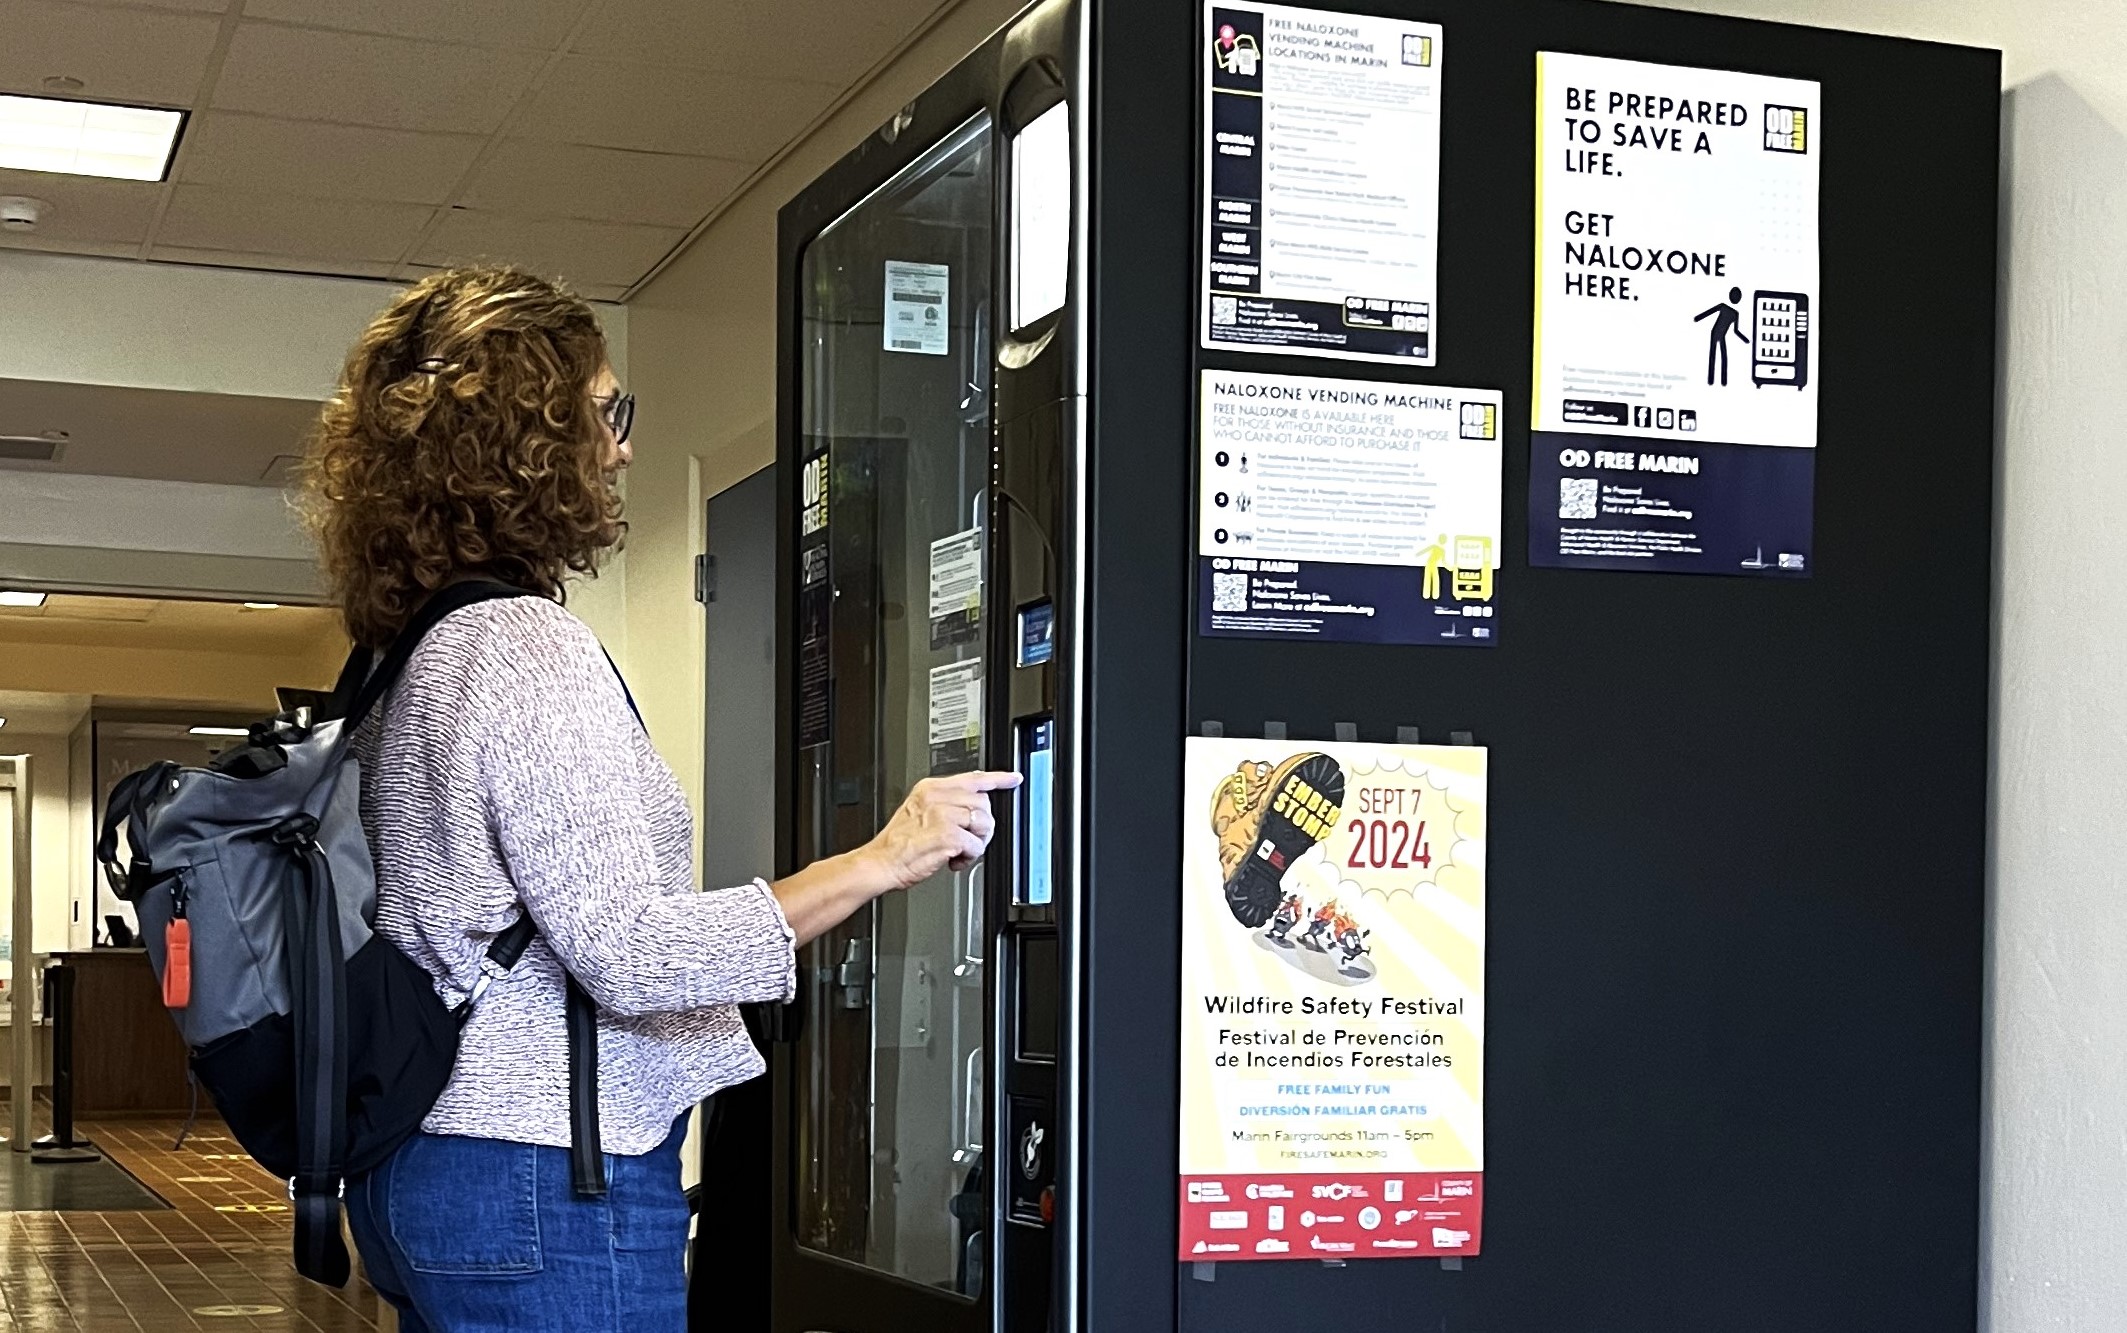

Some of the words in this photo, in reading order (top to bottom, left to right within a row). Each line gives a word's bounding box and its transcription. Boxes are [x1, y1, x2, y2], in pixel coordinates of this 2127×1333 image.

[1269, 47, 1330, 63] LOCATIONS
[1566, 87, 1596, 112] BE
[1608, 91, 1748, 127] PREPARED
[1565, 118, 1601, 143] TO
[1613, 123, 1682, 151] SAVE
[1693, 131, 1712, 155] A
[1565, 149, 1623, 177] LIFE.
[1565, 210, 1614, 237] GET
[1565, 241, 1726, 277] NALOXONE
[1565, 272, 1639, 301] HERE.
[1214, 382, 1302, 401] NALOXONE
[1308, 389, 1378, 407] VENDING
[1384, 393, 1453, 411] MACHINE
[1213, 403, 1236, 415] FREE
[1239, 405, 1298, 419] NALOXONE
[1302, 409, 1310, 420] IS
[1314, 410, 1367, 425] AVAILABLE
[1370, 414, 1395, 425] HERE
[1213, 416, 1233, 427] FOR
[1238, 417, 1271, 430] THOSE
[1275, 420, 1323, 433] WITHOUT
[1327, 423, 1386, 437] INSURANCE
[1390, 428, 1414, 439] AND
[1417, 429, 1449, 442] THOSE
[1213, 429, 1242, 441] WHO
[1245, 430, 1292, 443] CANNOT
[1296, 434, 1337, 446] AFFORD
[1340, 437, 1355, 448] TO
[1358, 438, 1410, 451] PURCHASE
[1412, 441, 1422, 452] IT
[1559, 448, 1591, 468] OD
[1594, 450, 1635, 470] FREE
[1638, 453, 1699, 475] MARIN
[1284, 774, 1341, 828] EMBER
[1359, 787, 1406, 815] SEPT
[1411, 789, 1421, 815] 7
[1273, 792, 1332, 842] STOMP
[1347, 819, 1431, 869] 2024
[1204, 995, 1293, 1015] Wildfire
[1301, 996, 1373, 1019] Safety
[1381, 997, 1464, 1015] Festival
[1219, 1029, 1296, 1045] Festival
[1302, 1029, 1326, 1045] de
[1334, 1029, 1444, 1046] Prevención
[1215, 1051, 1239, 1067] de
[1247, 1051, 1344, 1067] Incendios
[1351, 1051, 1452, 1067] Forestales
[1278, 1084, 1311, 1095] FREE
[1314, 1084, 1361, 1095] FAMILY
[1365, 1084, 1390, 1095] FUN
[1239, 1103, 1311, 1116] DIVERSIÓN
[1314, 1105, 1376, 1116] FAMILIAR
[1380, 1105, 1427, 1116] GRATIS
[1275, 1130, 1353, 1143] Fairgrounds
[1357, 1130, 1389, 1141] 11am
[1405, 1129, 1435, 1143] 5pm
